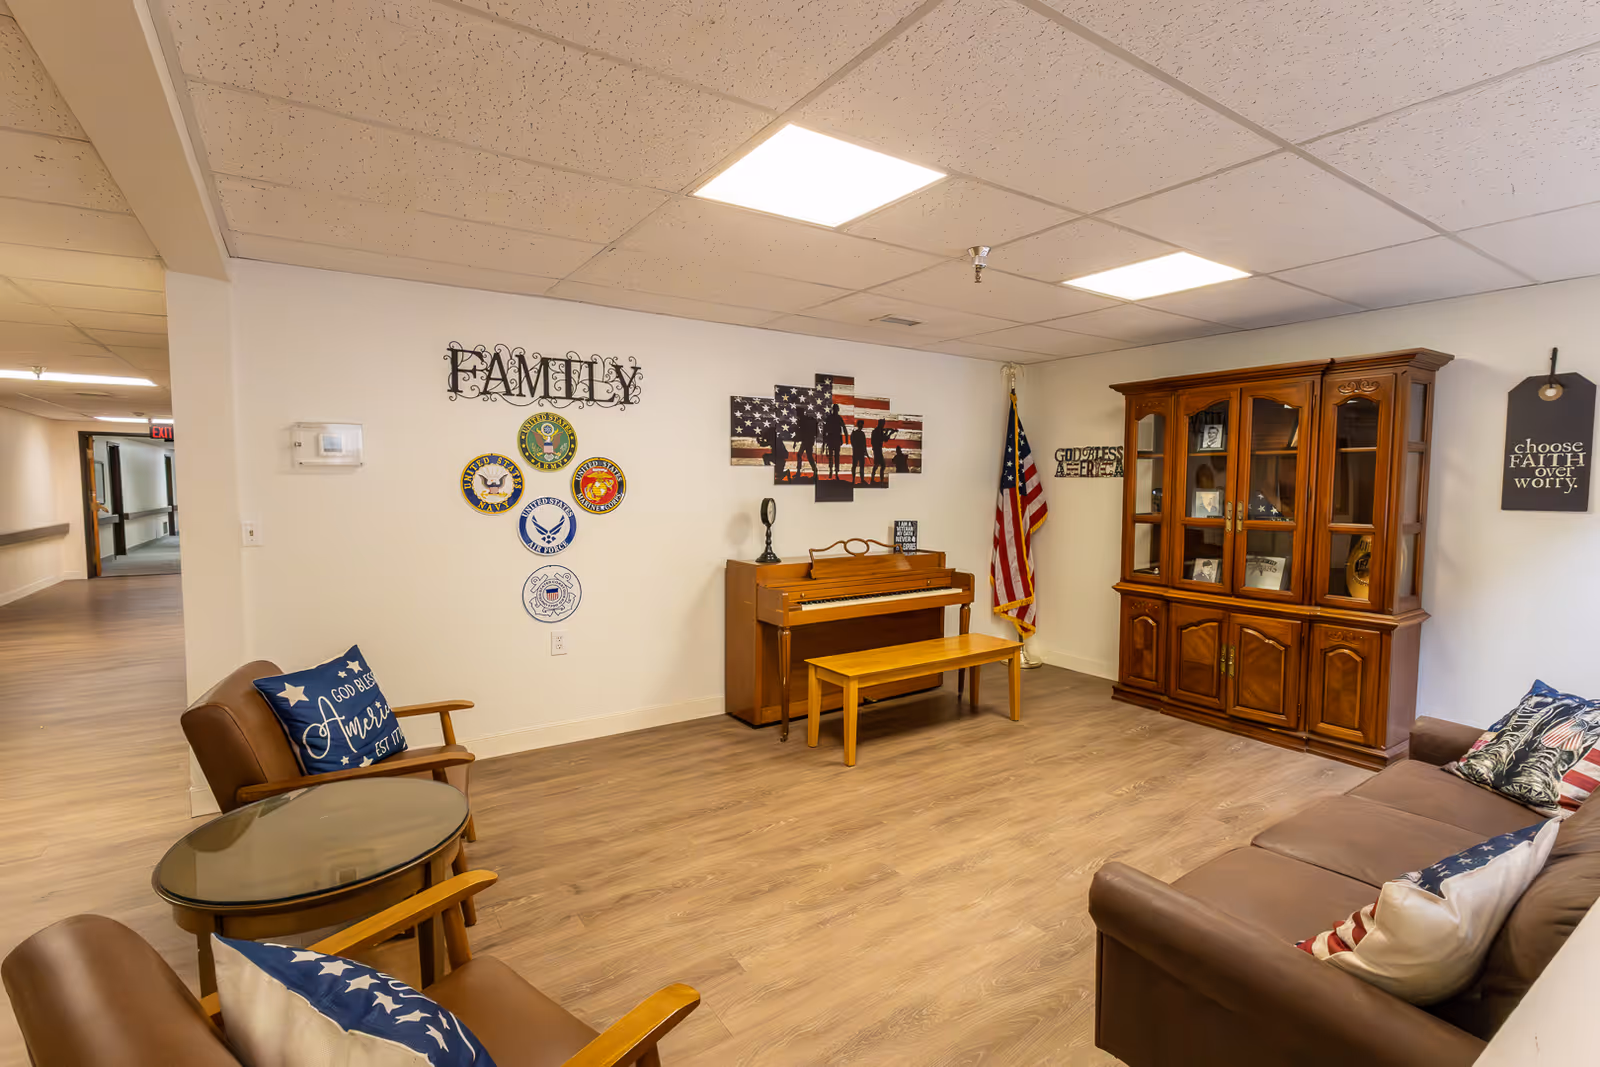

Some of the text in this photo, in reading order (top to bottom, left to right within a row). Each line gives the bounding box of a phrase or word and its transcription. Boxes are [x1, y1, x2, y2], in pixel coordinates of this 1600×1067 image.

[445, 343, 642, 408] FAMILY
[152, 426, 173, 439] EXIT
[521, 414, 572, 434] UNITED STATES
[1054, 445, 1124, 462] GOD BLESS
[1514, 438, 1583, 454] choose
[535, 461, 564, 471] ARMY
[1509, 452, 1587, 468] FAITH
[463, 456, 522, 490] UNITED STATES
[575, 460, 623, 481] UNITED STATES
[1054, 460, 1124, 478] AMERICA
[1535, 466, 1575, 477] over
[1514, 477, 1578, 494] worry.
[477, 500, 510, 512] NAVY
[521, 498, 574, 518] UNITED STATES
[576, 493, 624, 512] MARINE CORPS
[528, 541, 569, 554] AIR FORCE
[331, 684, 355, 703] GOD
[375, 736, 391, 757] EST
